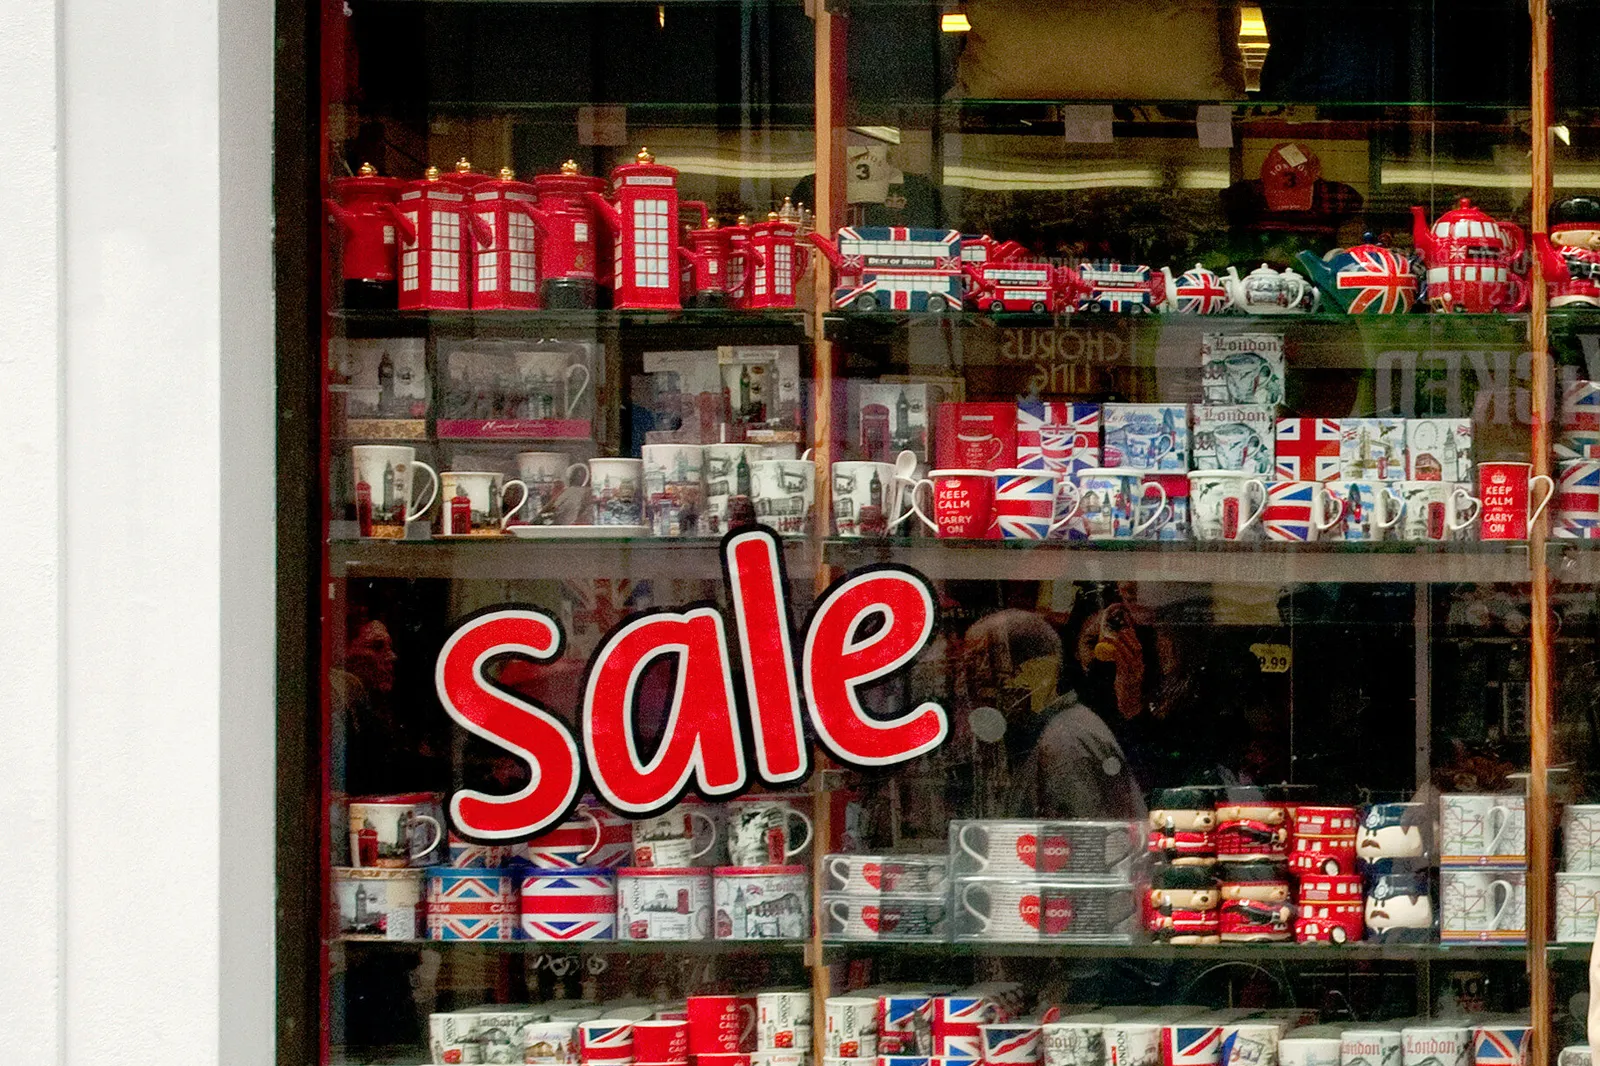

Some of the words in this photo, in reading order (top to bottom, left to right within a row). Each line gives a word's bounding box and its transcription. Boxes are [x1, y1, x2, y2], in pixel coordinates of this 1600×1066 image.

[856, 163, 871, 181] 3
[1214, 336, 1279, 352] London
[939, 489, 969, 499] KEEP
[1486, 486, 1513, 495] KEEP
[938, 500, 971, 509] CALM
[1484, 497, 1513, 506] CALM
[938, 515, 972, 525] CARRY
[1483, 512, 1514, 522] CARRY
[946, 524, 964, 534] ON
[1489, 523, 1507, 533] ON
[1407, 1035, 1456, 1055] London
